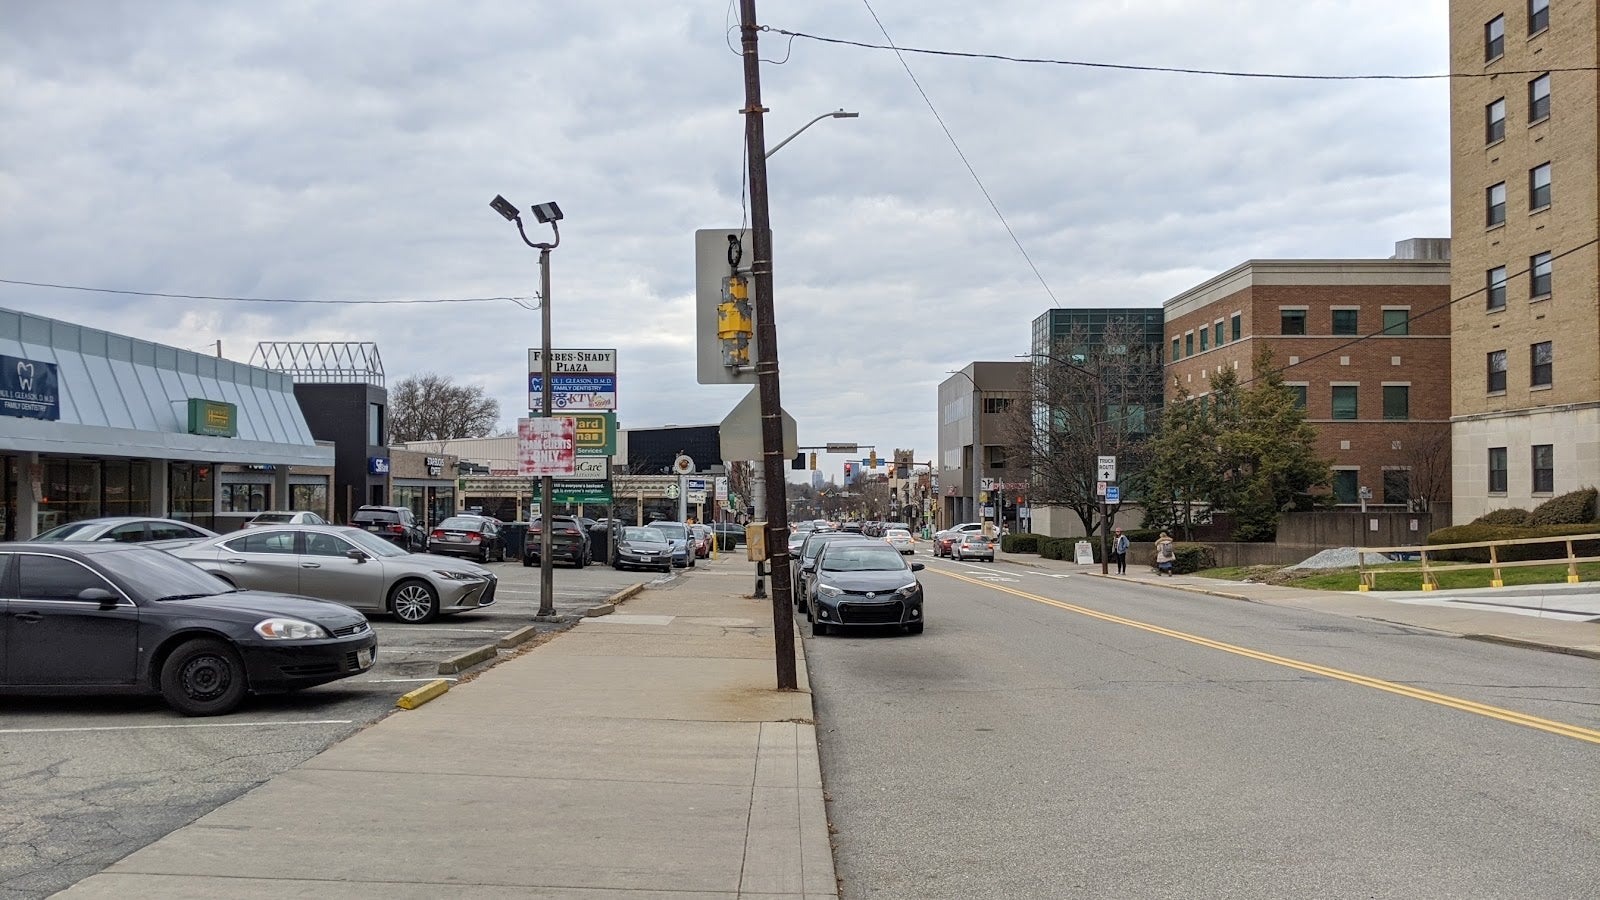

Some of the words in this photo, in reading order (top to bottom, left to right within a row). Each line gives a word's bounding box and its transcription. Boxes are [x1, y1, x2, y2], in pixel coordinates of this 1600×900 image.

[533, 351, 611, 361] FRBES-SHADY
[556, 362, 588, 372] PLAZA
[576, 420, 599, 428] ard
[575, 461, 602, 471] aCare
